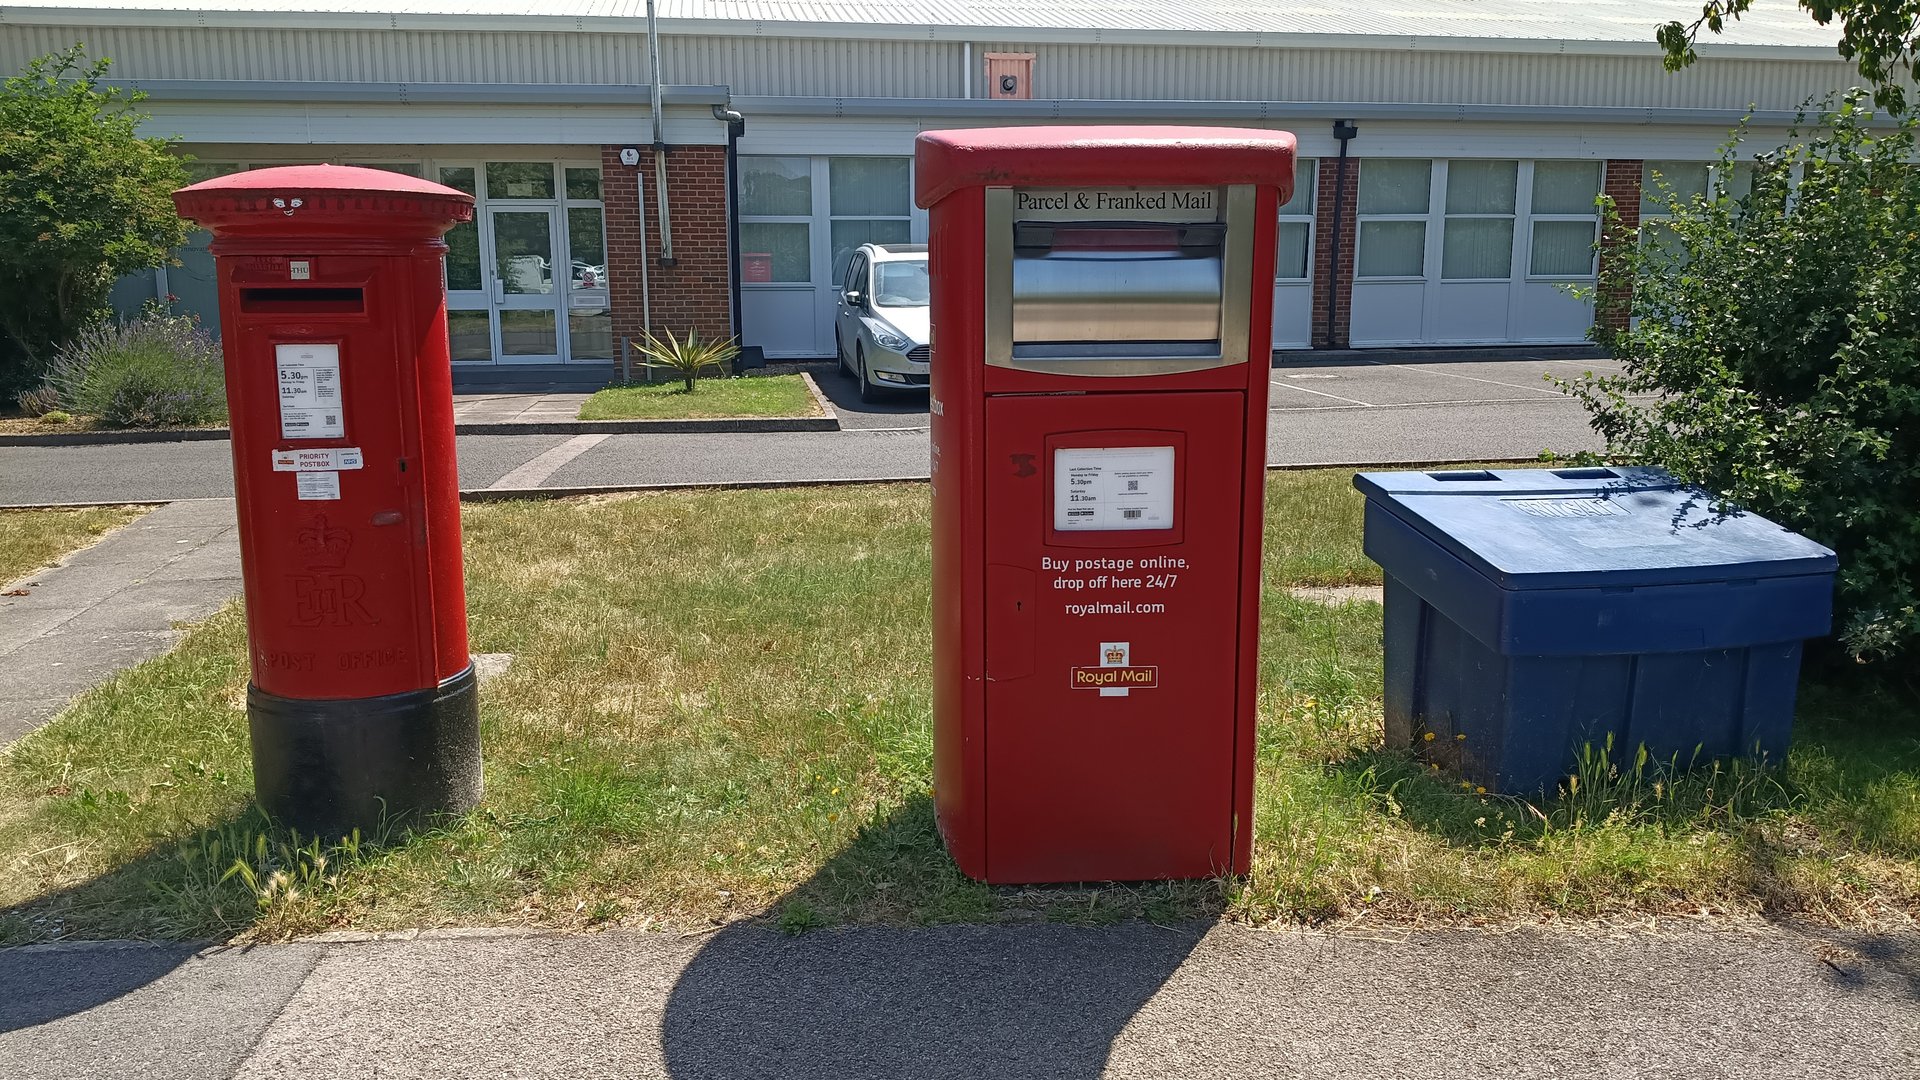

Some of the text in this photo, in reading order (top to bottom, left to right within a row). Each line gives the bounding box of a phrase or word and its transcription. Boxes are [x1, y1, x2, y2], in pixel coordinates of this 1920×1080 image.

[1017, 191, 1212, 210] Parcel & Franked Mail
[280, 370, 309, 380] 5.30pm
[1042, 556, 1190, 572] Buy postage online,
[1053, 574, 1178, 592] drop off here 24/7
[1065, 601, 1165, 617] royalmail.com
[1077, 670, 1152, 686] Royal Mail
